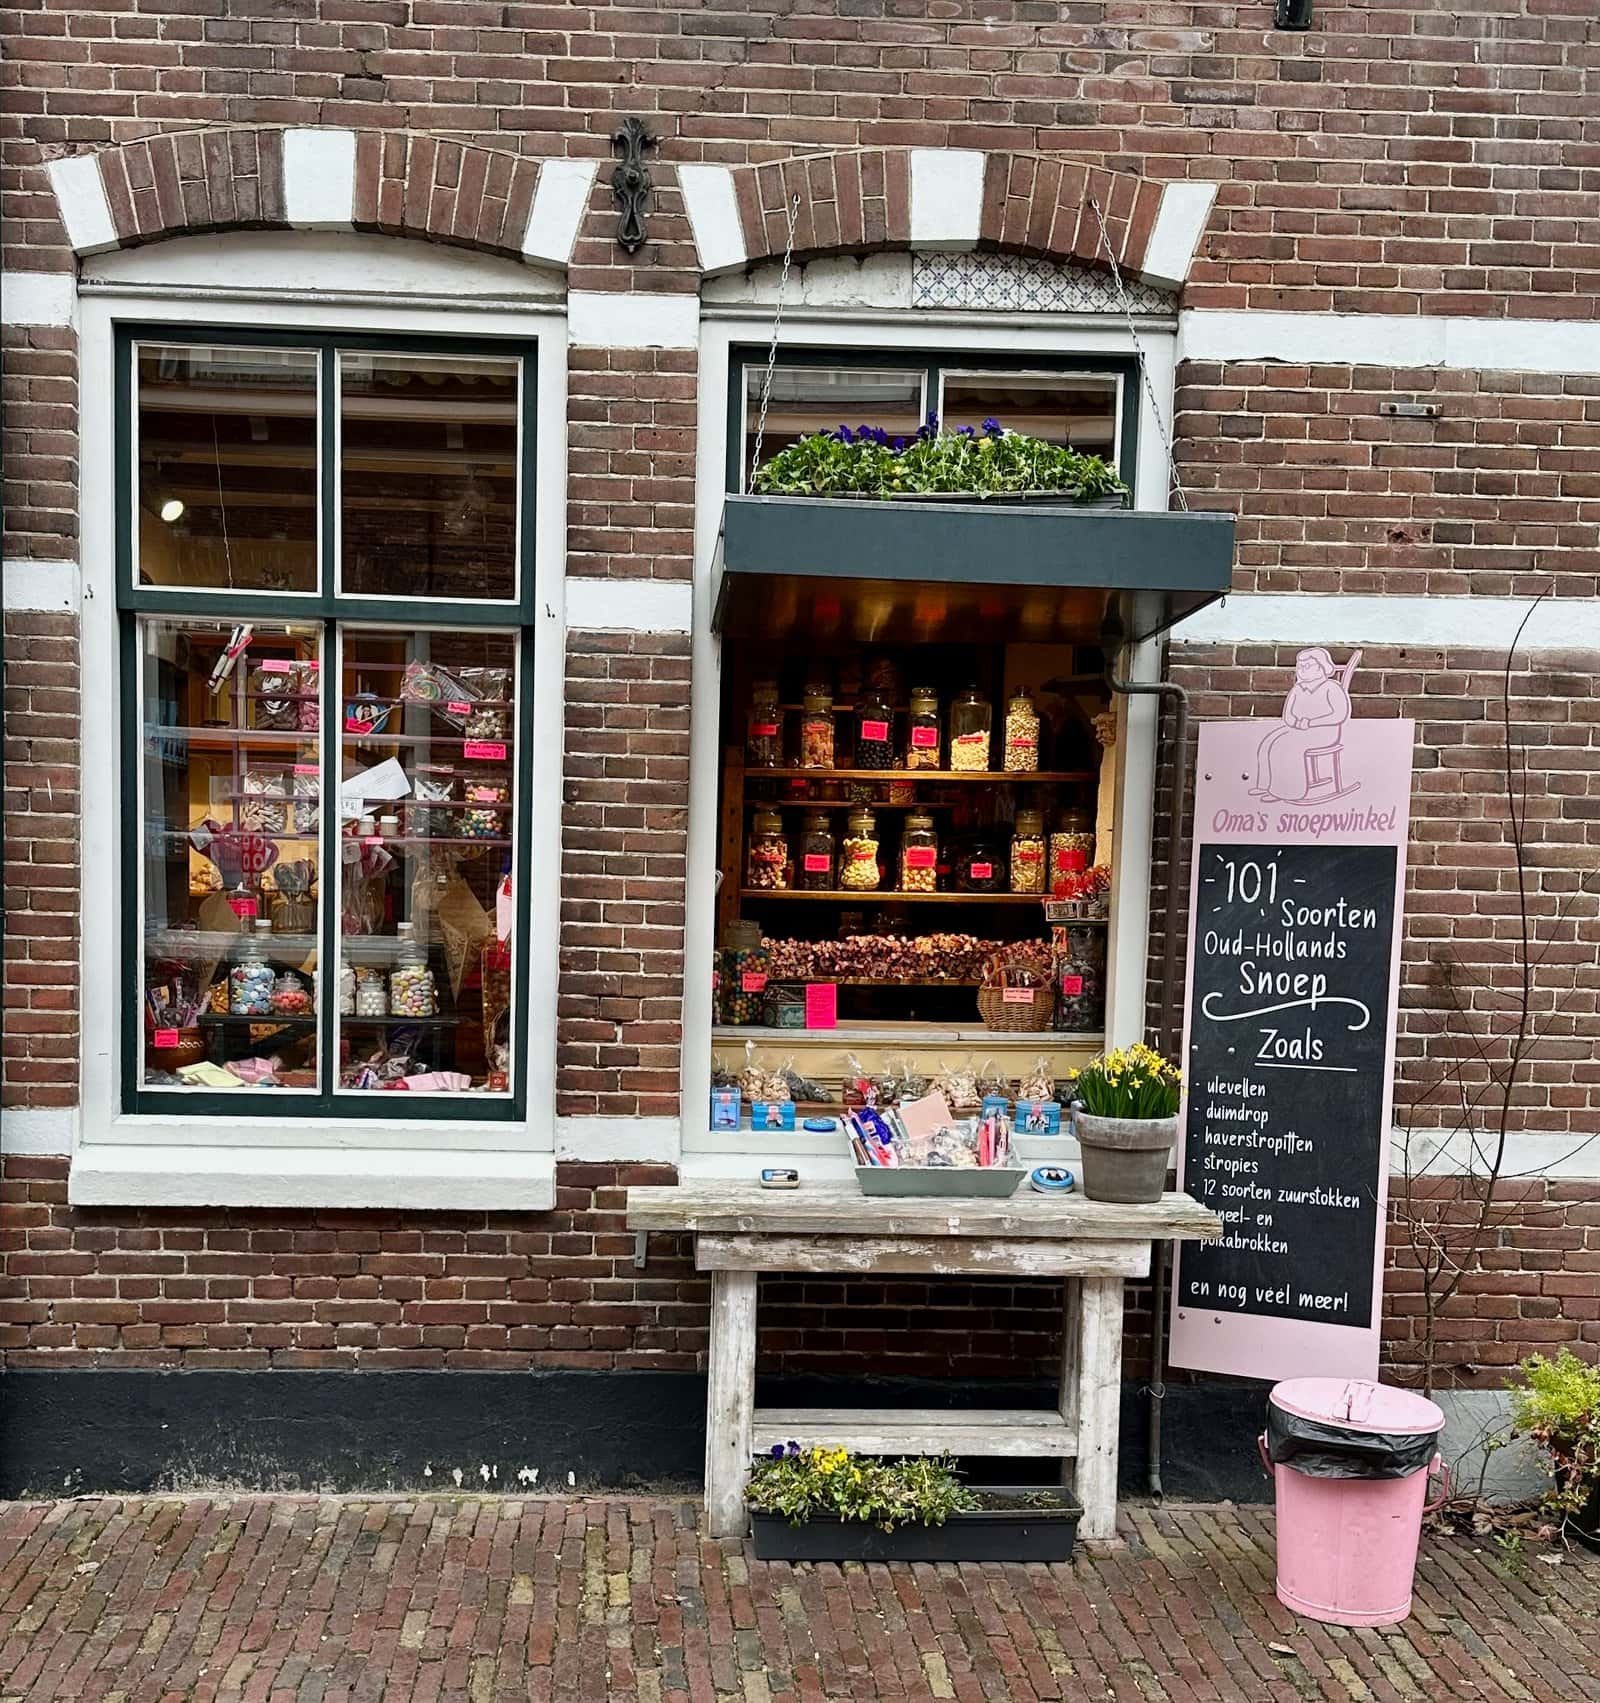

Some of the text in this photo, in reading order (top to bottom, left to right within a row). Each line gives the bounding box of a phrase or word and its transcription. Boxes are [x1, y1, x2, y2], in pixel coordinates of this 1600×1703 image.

[1212, 804, 1396, 839] Oma's snoepwinkel
[1224, 861, 1277, 904] 101
[1280, 896, 1376, 929] Soorten
[1204, 928, 1347, 962] Oud-Hollands
[1239, 960, 1327, 1011] Snoep
[1256, 1026, 1324, 1061] Zoals
[1207, 1075, 1266, 1098] ulevellen
[1206, 1101, 1269, 1129] duimdrop
[1203, 1151, 1259, 1178] stropies
[1203, 1178, 1360, 1209] 12 soorten zuurstokken
[1202, 1202, 1273, 1227] neel- en
[1190, 1280, 1209, 1296] en
[1218, 1282, 1247, 1307] nog
